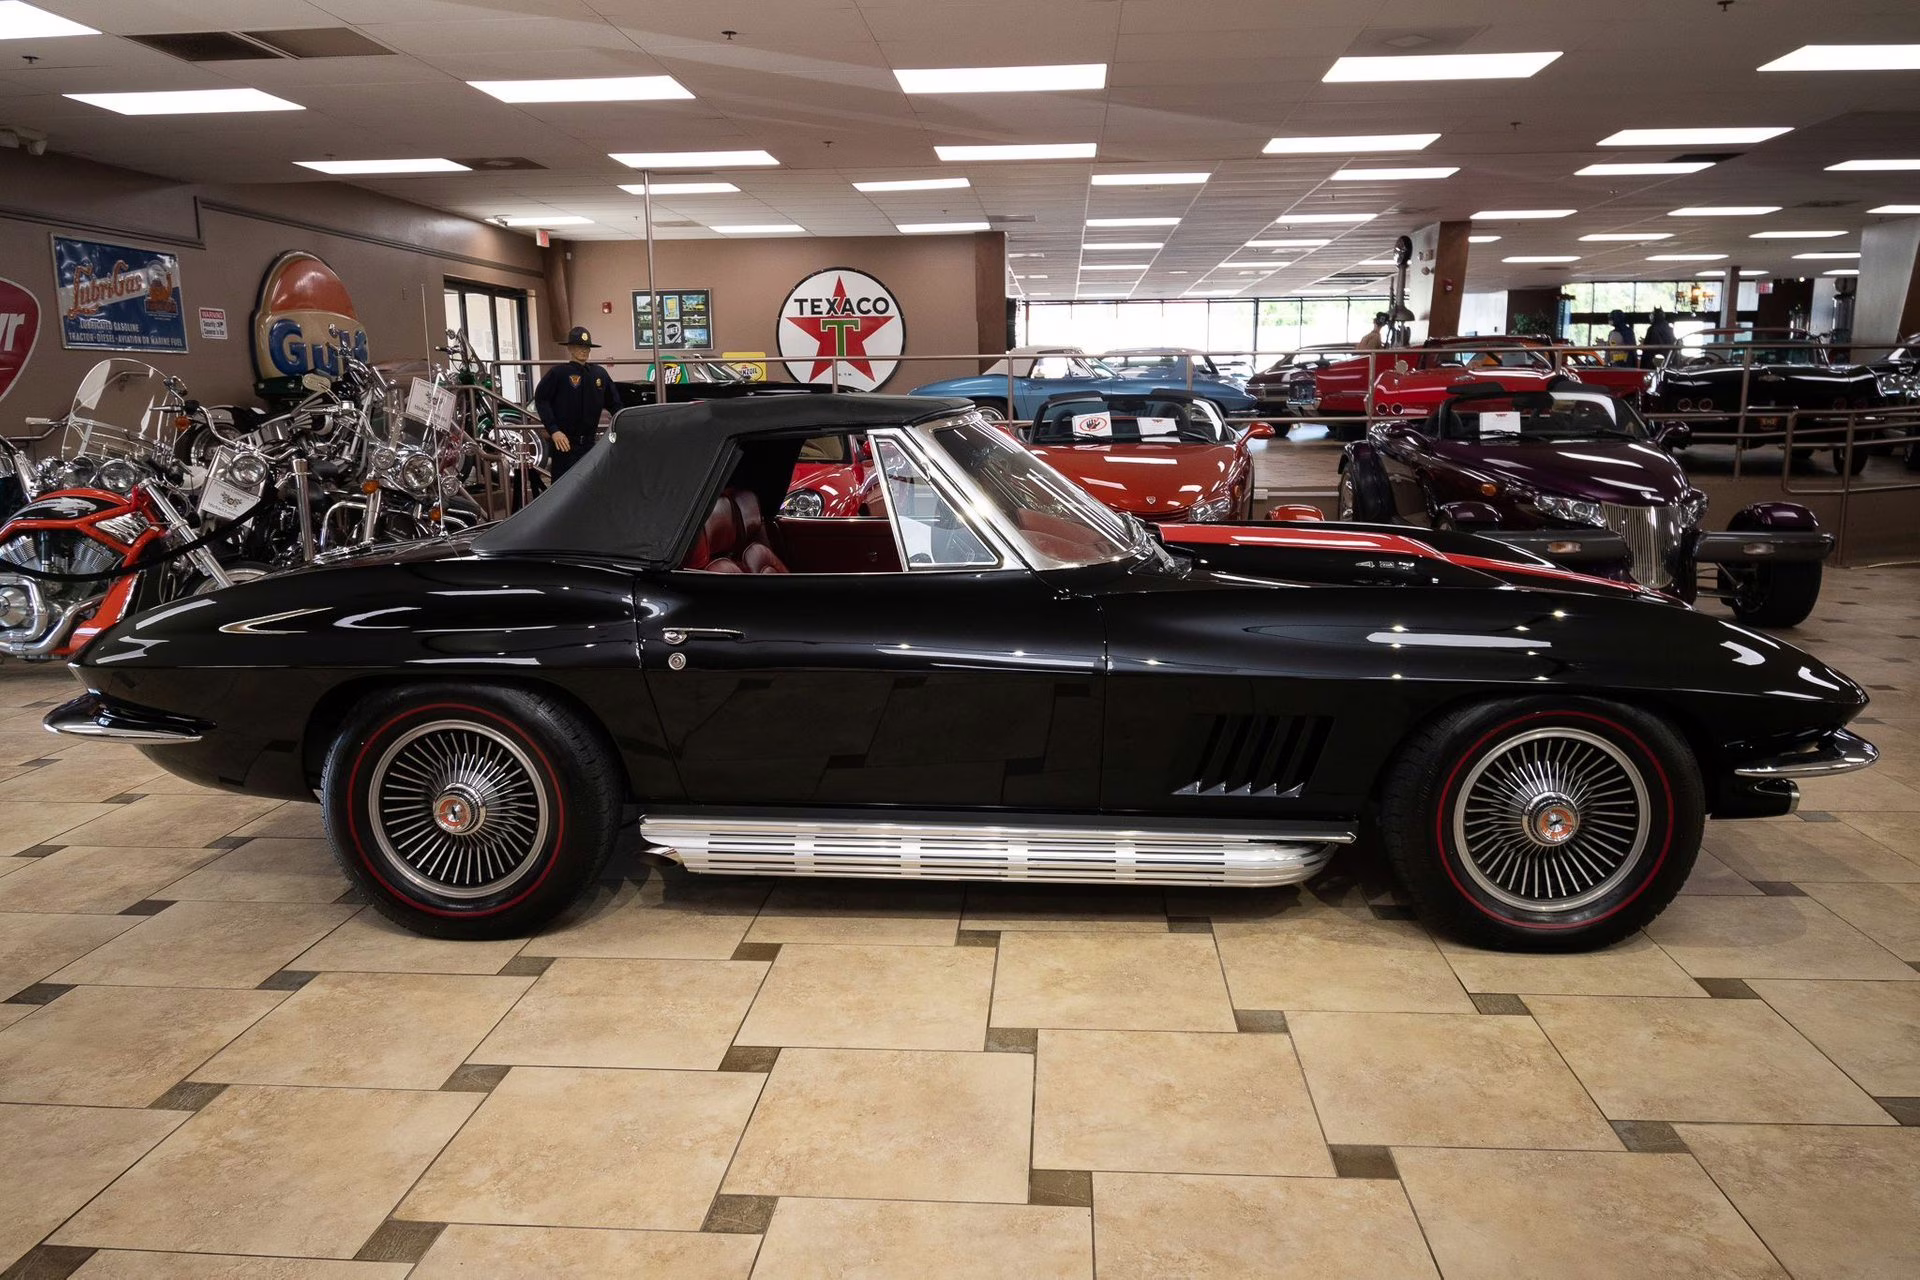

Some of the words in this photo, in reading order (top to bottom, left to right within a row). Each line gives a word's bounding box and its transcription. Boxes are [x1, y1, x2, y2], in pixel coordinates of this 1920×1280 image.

[794, 297, 889, 315] TEXACO
[80, 319, 113, 331] LUBRICATED
[113, 322, 140, 333] GASOLINE
[150, 336, 170, 345] MARINE
[171, 338, 183, 346] FUEL
